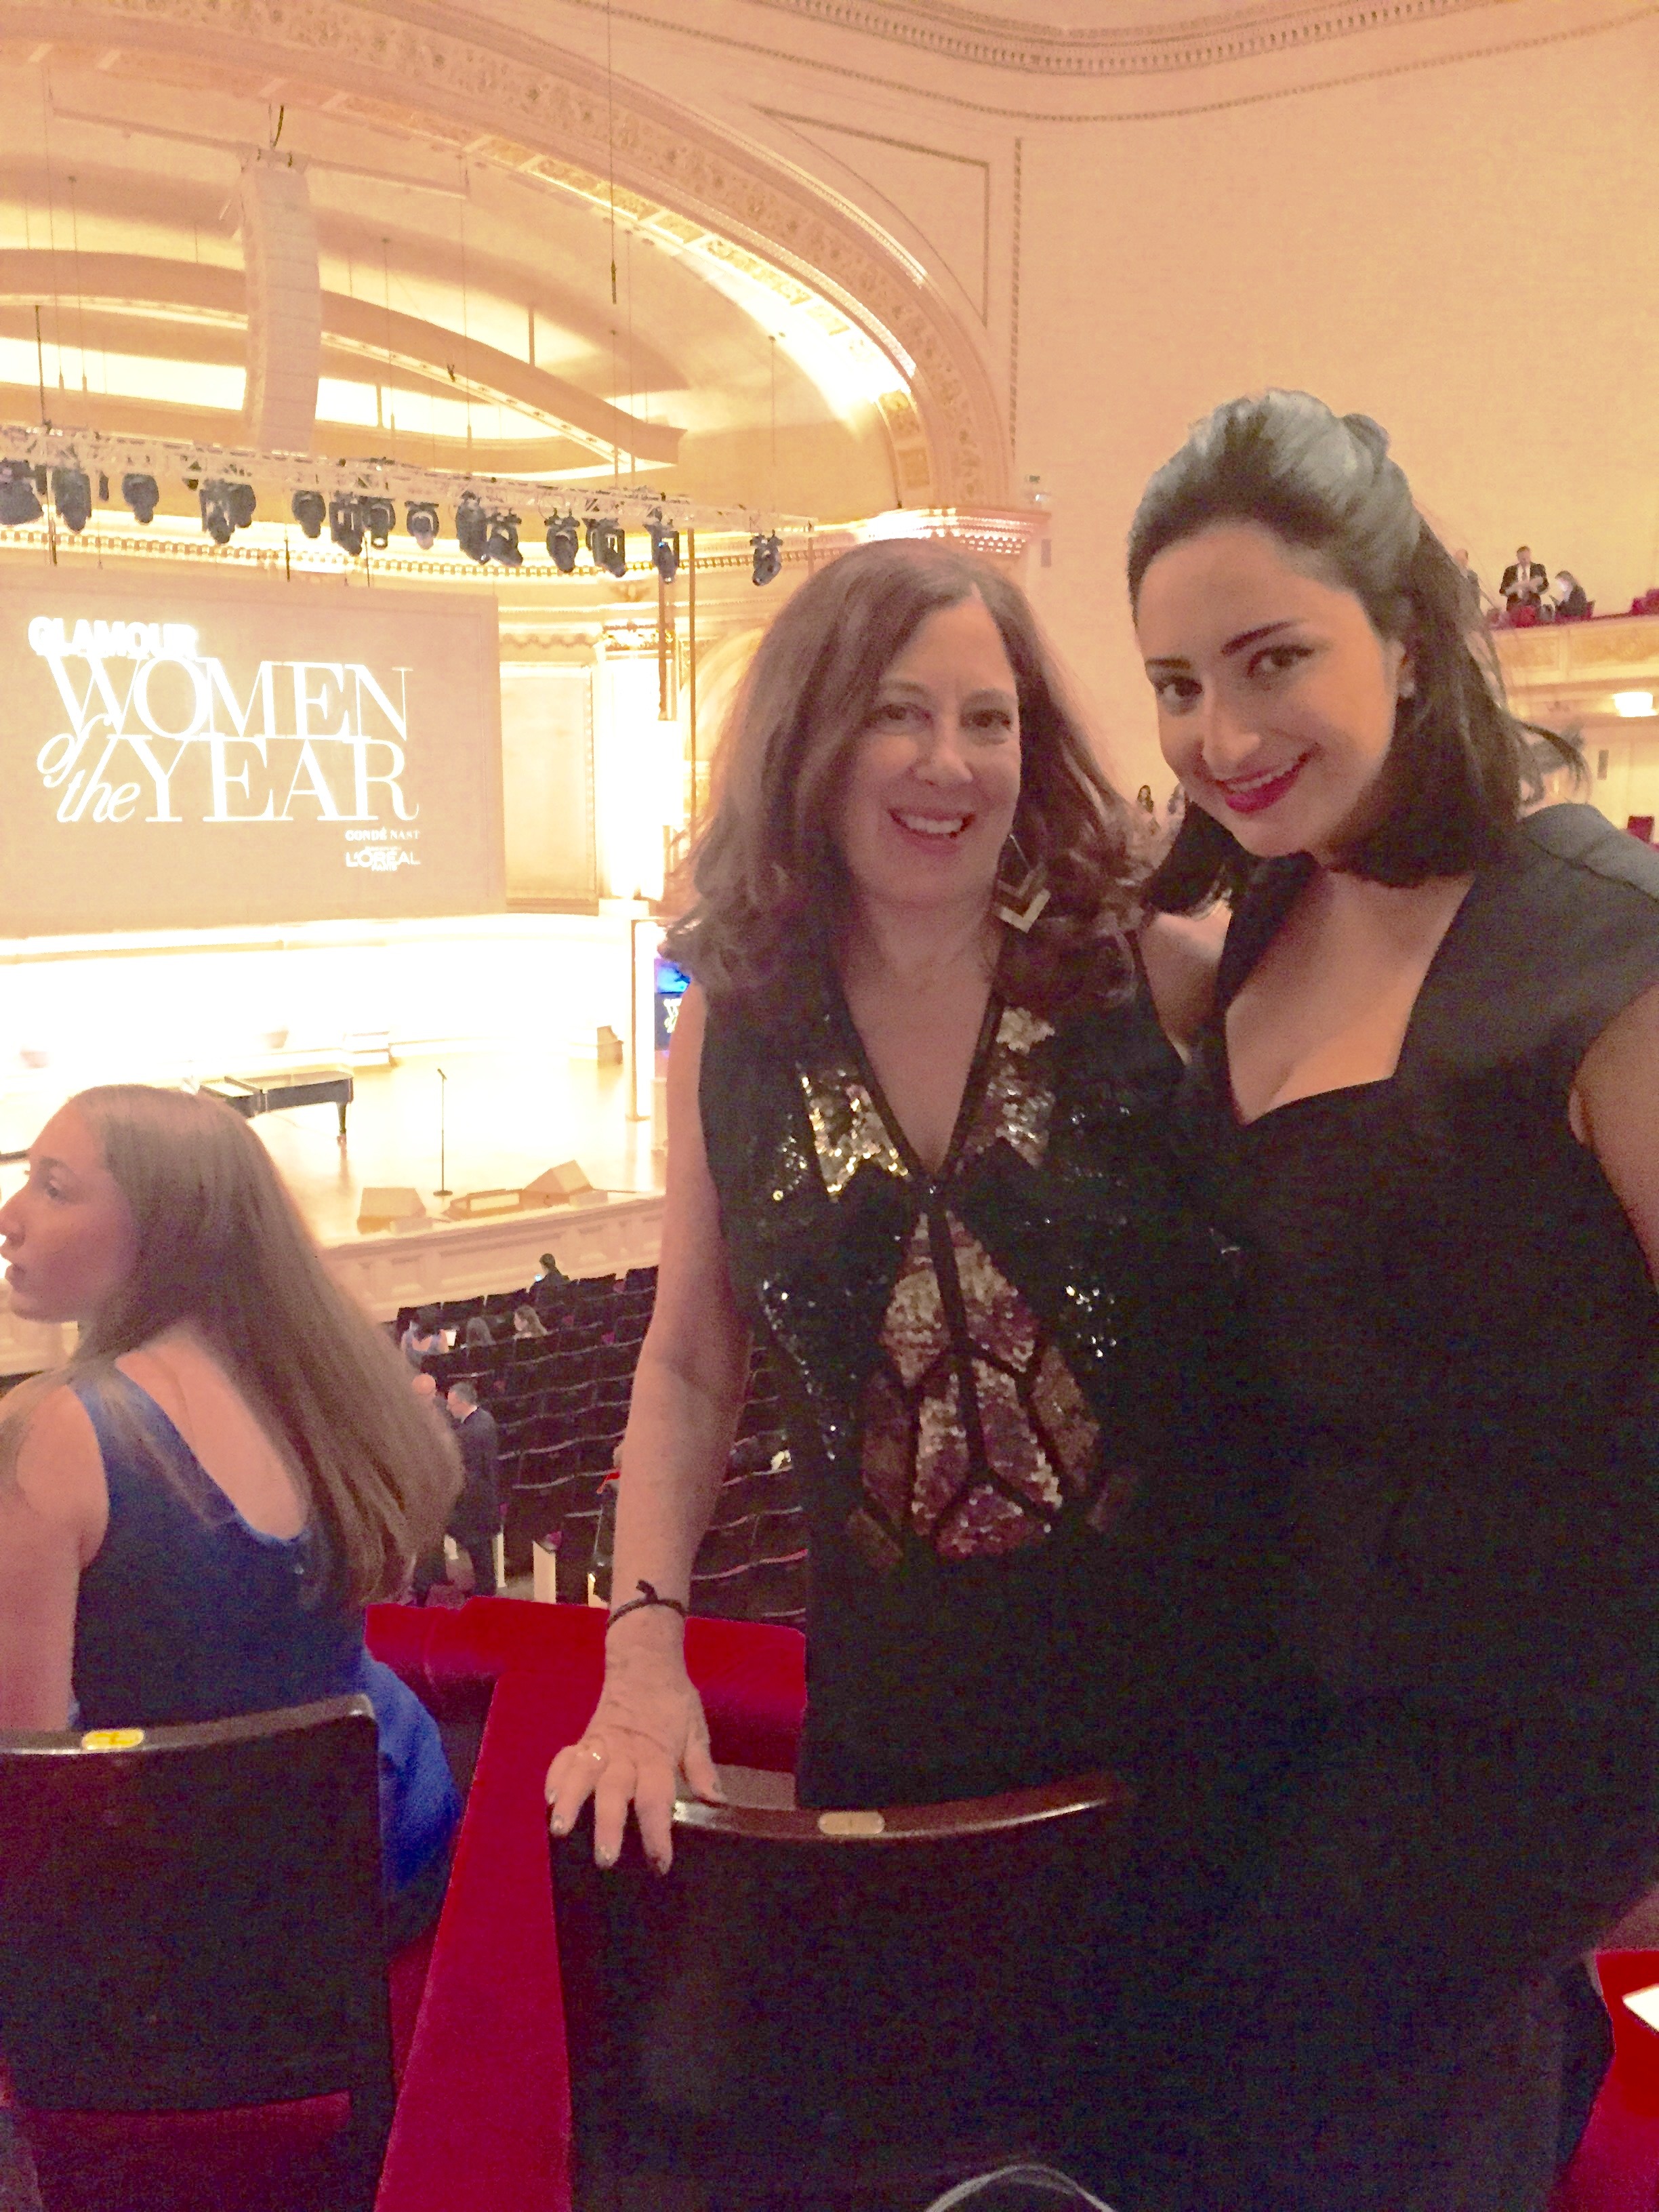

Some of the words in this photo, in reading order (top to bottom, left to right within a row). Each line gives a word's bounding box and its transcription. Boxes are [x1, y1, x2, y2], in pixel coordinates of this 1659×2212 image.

[28, 616, 199, 658] GLAMOUR
[41, 652, 413, 741] WOMEN
[37, 713, 112, 788] of
[56, 735, 140, 823] the
[106, 733, 419, 822] YEAR
[344, 826, 388, 842] CONDÉ
[390, 830, 421, 840] NAST
